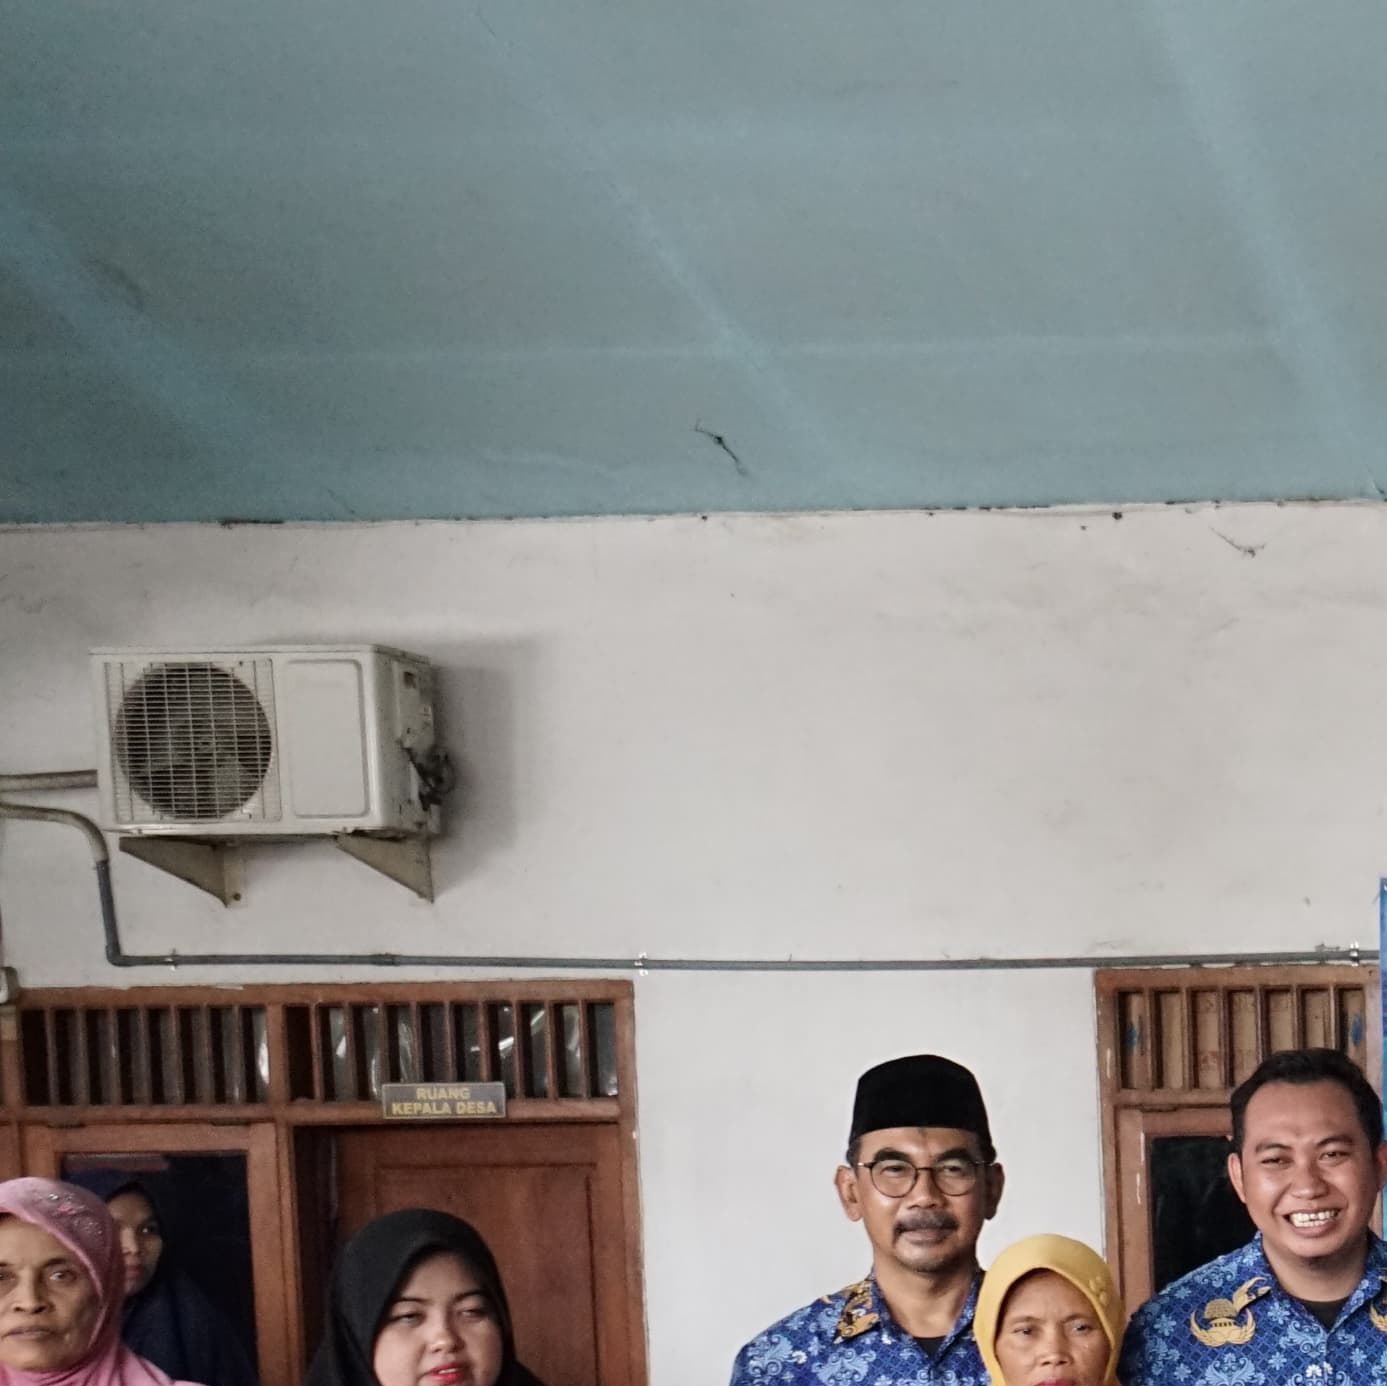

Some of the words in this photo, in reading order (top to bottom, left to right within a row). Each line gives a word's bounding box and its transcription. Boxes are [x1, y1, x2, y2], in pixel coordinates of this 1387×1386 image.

[416, 1087, 471, 1100] RUANG
[392, 1103, 452, 1115] KEPALA
[456, 1101, 498, 1114] DESA
